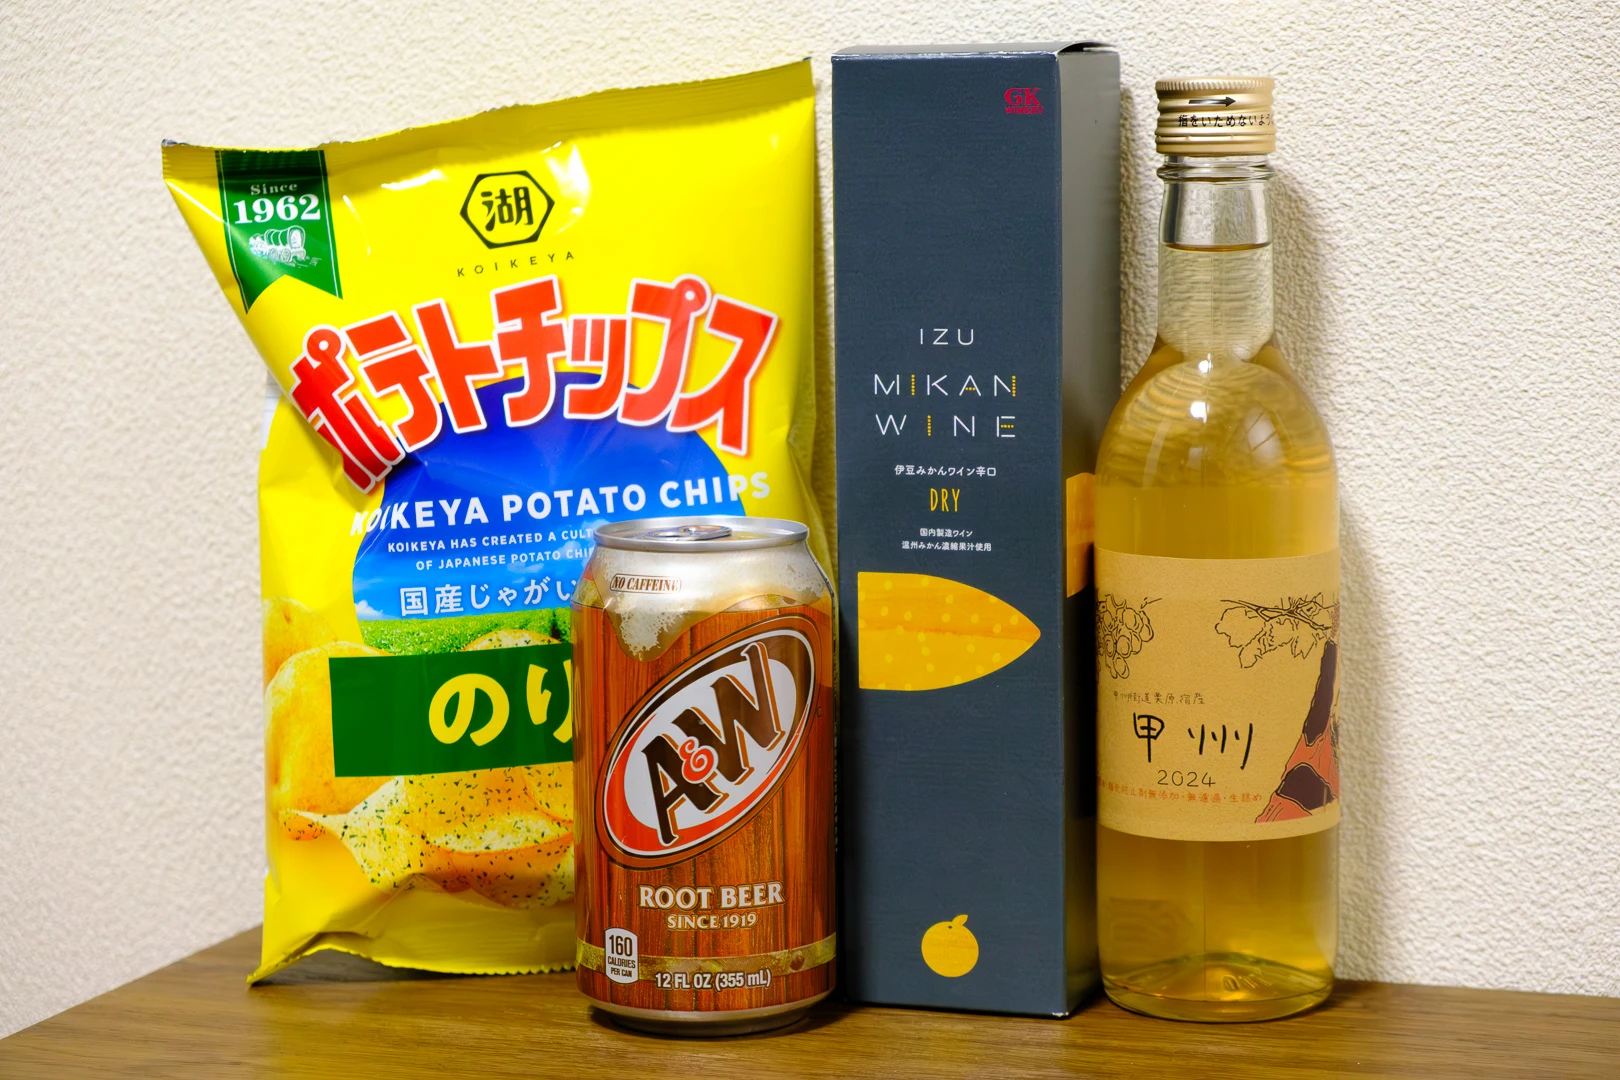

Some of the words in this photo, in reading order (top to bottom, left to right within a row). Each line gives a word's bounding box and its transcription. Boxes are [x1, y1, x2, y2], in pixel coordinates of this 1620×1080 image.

[1004, 87, 1041, 105] GK
[250, 183, 298, 195] Since
[233, 194, 321, 224] 1962
[481, 186, 534, 232] 湖
[457, 251, 574, 277] KOIKEYA
[920, 328, 974, 345] IZU
[288, 273, 778, 494] ポテトチップス
[874, 374, 1016, 397] MIKAN
[875, 414, 1015, 437] WINE
[894, 465, 997, 477] 伊豆みかんワイン辛口
[350, 496, 489, 536] KOIKEYA
[503, 484, 646, 521] POTATO
[659, 472, 771, 508] CHIPS
[930, 488, 960, 512] DRY
[388, 537, 446, 553] KOIKEYA
[450, 536, 477, 549] HAS
[482, 532, 542, 547] CREATED
[548, 531, 556, 542] A
[919, 528, 973, 538] 国内製造ワイン
[416, 560, 433, 571] OF
[438, 555, 506, 569] JAPANESE
[511, 550, 560, 563] POTATO
[612, 577, 625, 589] NO
[627, 578, 679, 591] CAFFEINE
[429, 659, 572, 746] のり
[641, 641, 786, 846] A&W
[1133, 712, 1253, 770] 甲州
[1157, 769, 1216, 787] 2024
[639, 885, 712, 909] ROOT
[720, 882, 785, 907] BEER
[667, 914, 718, 929] SINCE
[722, 913, 757, 929] 1919
[608, 934, 633, 957] 160
[607, 955, 636, 969] CALORIES
[611, 967, 621, 976] PER
[622, 969, 632, 978] CAN
[655, 972, 671, 988] 12
[675, 973, 691, 989] FL
[693, 973, 712, 989] OZ
[715, 972, 745, 991] (355
[747, 968, 772, 988] mL)
